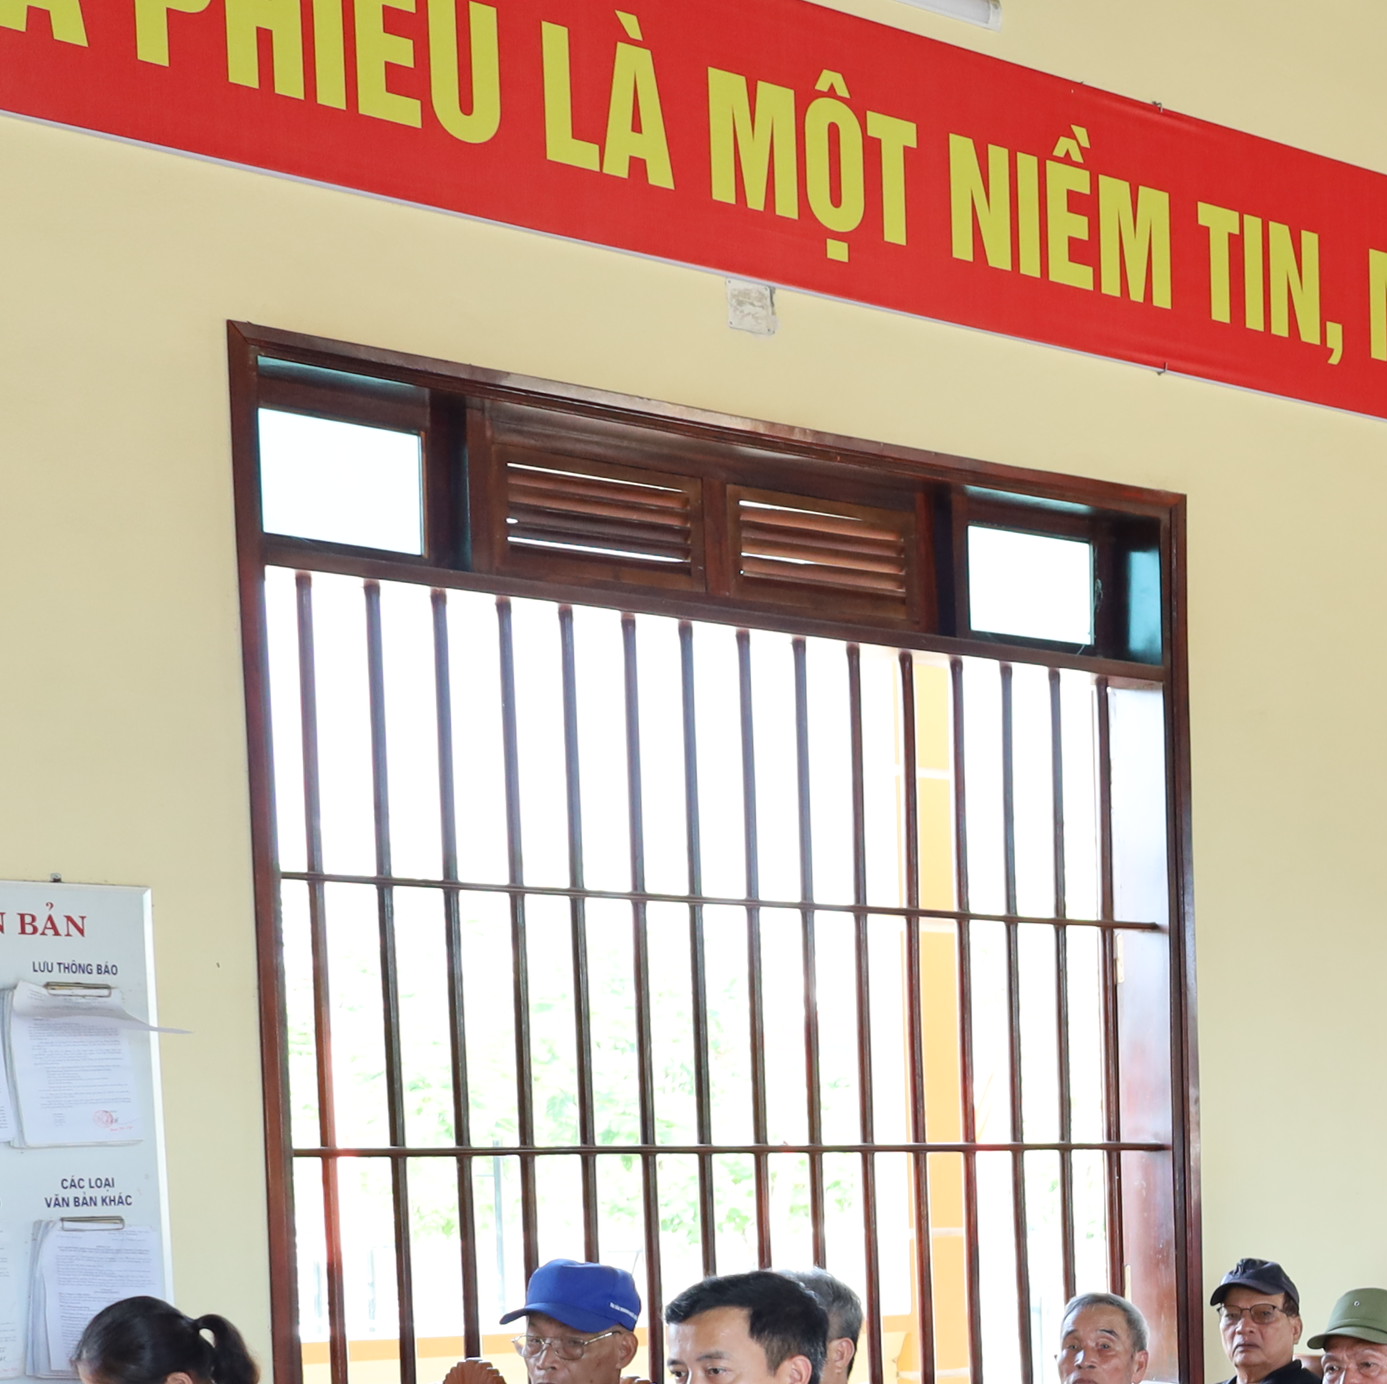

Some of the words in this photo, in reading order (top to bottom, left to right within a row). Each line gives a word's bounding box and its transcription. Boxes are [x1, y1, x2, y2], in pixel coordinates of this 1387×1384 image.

[541, 10, 675, 190] LÀ
[707, 69, 917, 263] MỘT
[949, 124, 1172, 310] NIỀM
[1197, 201, 1344, 365] TIN,
[16, 901, 87, 938] BẢN
[32, 960, 54, 973] LƯU
[56, 959, 94, 975] THÔNG
[96, 961, 119, 976] BÁO
[60, 1175, 85, 1190] CÁC
[88, 1177, 115, 1192] LOẠI
[44, 1193, 70, 1208] VĂN
[73, 1191, 98, 1207] BẢN
[100, 1192, 133, 1207] KHÁC
